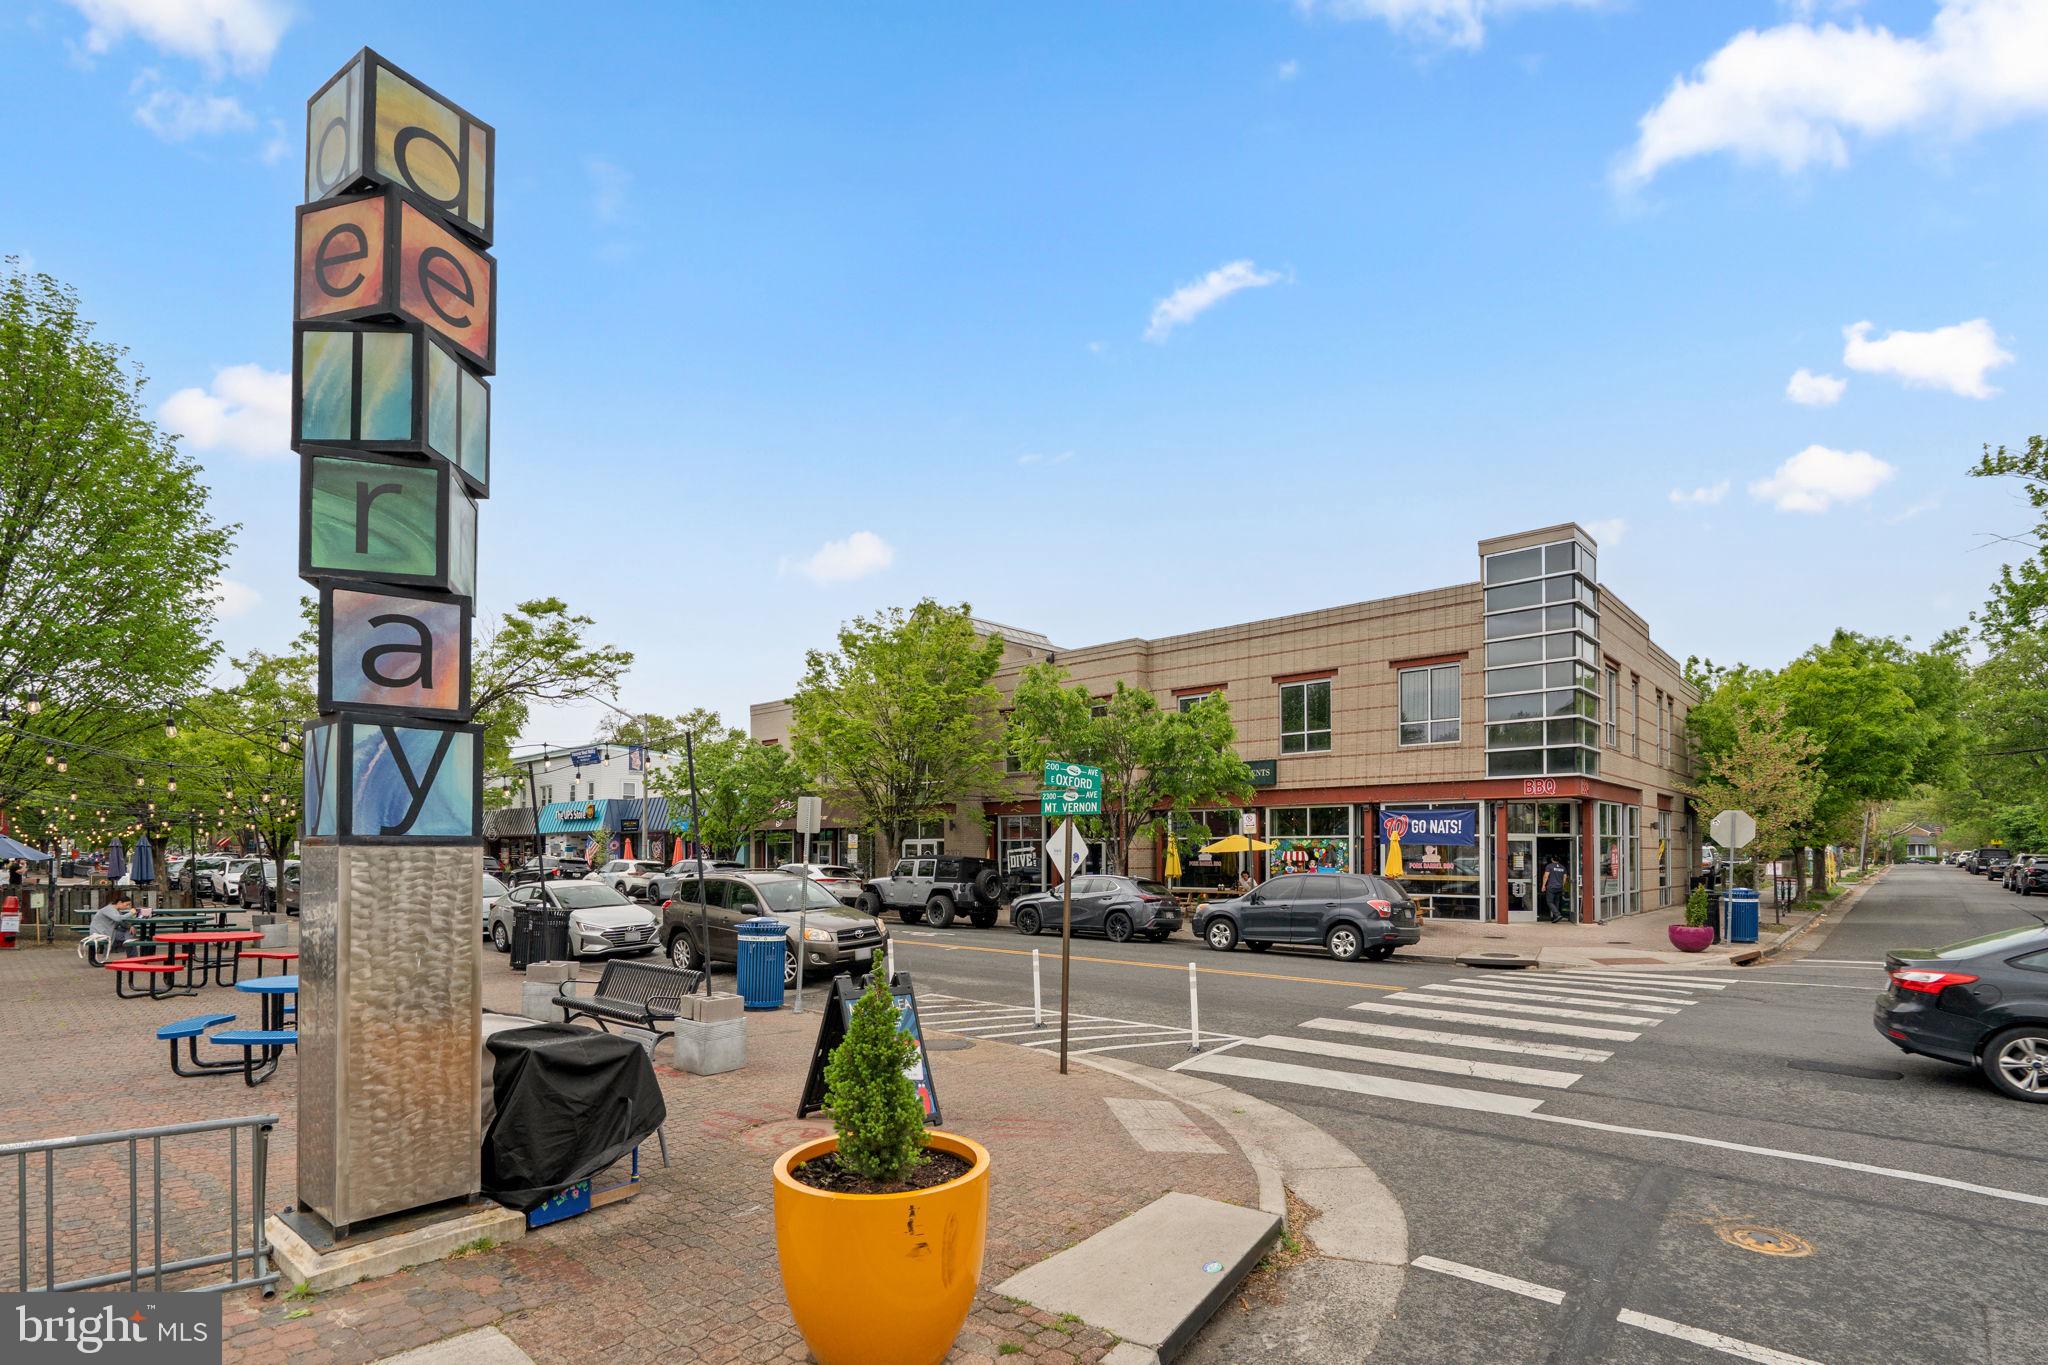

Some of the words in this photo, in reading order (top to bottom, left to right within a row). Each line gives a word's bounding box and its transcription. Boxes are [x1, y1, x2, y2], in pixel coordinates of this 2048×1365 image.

[1046, 763, 1060, 771] 200
[1088, 769, 1099, 777] AVE
[1056, 773, 1093, 789] OXFORD
[1524, 778, 1556, 795] BBQ
[1085, 791, 1098, 799] AVE
[1044, 802, 1058, 813] MT.
[1062, 801, 1098, 813] VERNON
[1411, 819, 1426, 834] GO
[1429, 819, 1462, 834] NATS!
